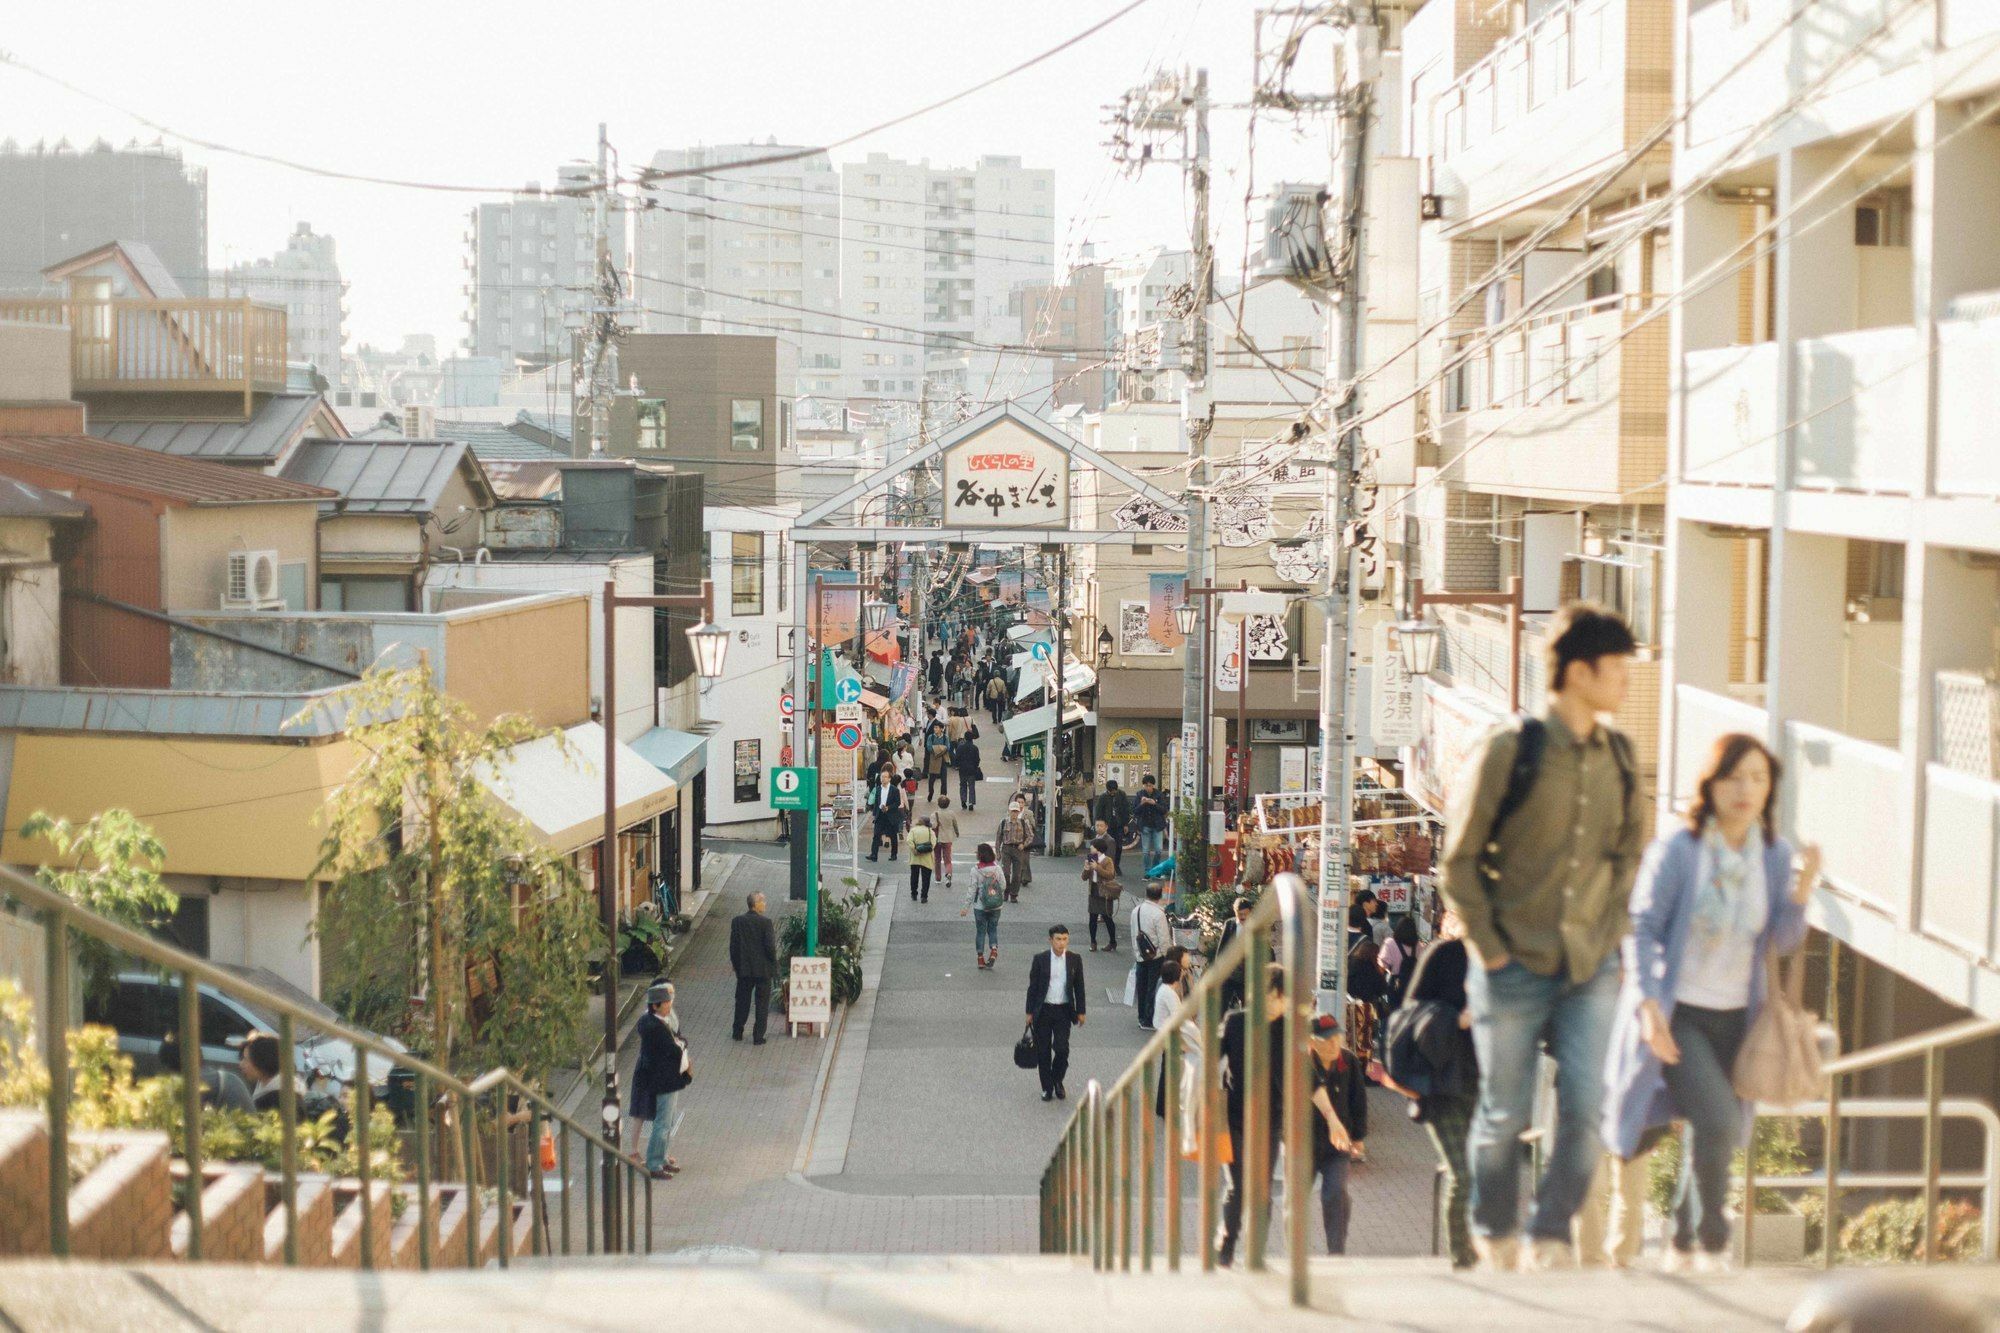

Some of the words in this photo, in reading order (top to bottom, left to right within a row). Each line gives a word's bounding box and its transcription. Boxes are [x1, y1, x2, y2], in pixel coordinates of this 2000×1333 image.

[968, 451, 1034, 471] ひぐらしの里
[954, 467, 1058, 517] 谷中ぎんざ
[1383, 654, 1397, 719] クリニック
[1378, 888, 1407, 902] 焼肉
[807, 980, 824, 990] LA
[791, 996, 828, 1007] PAPA
